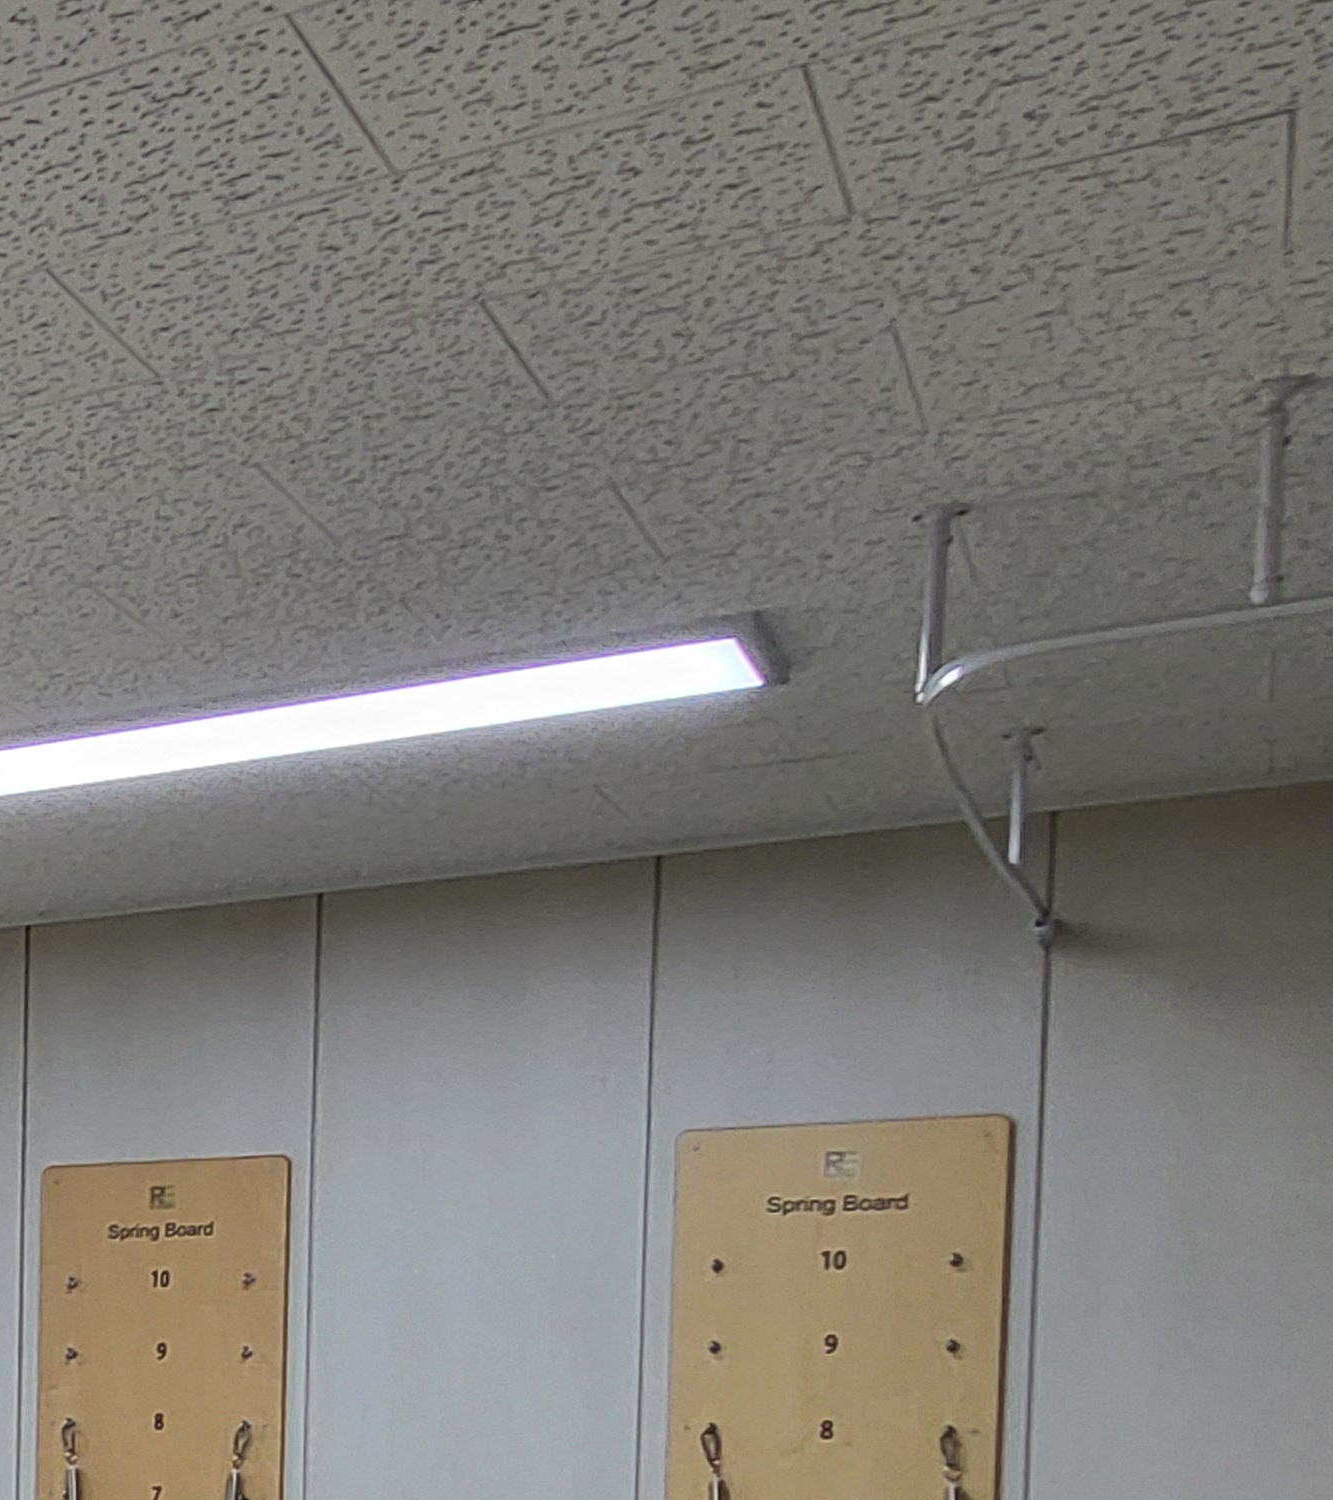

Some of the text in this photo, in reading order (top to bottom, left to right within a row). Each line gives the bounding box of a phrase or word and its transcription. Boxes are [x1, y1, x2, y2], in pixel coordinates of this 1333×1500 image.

[765, 1192, 910, 1217] Spring Board
[107, 1220, 215, 1242] Spring Board
[820, 1249, 848, 1271] 10
[150, 1269, 171, 1289] 10
[156, 1341, 168, 1361] 9
[824, 1333, 839, 1355] 9
[153, 1412, 165, 1431] 8
[819, 1419, 834, 1440] 8
